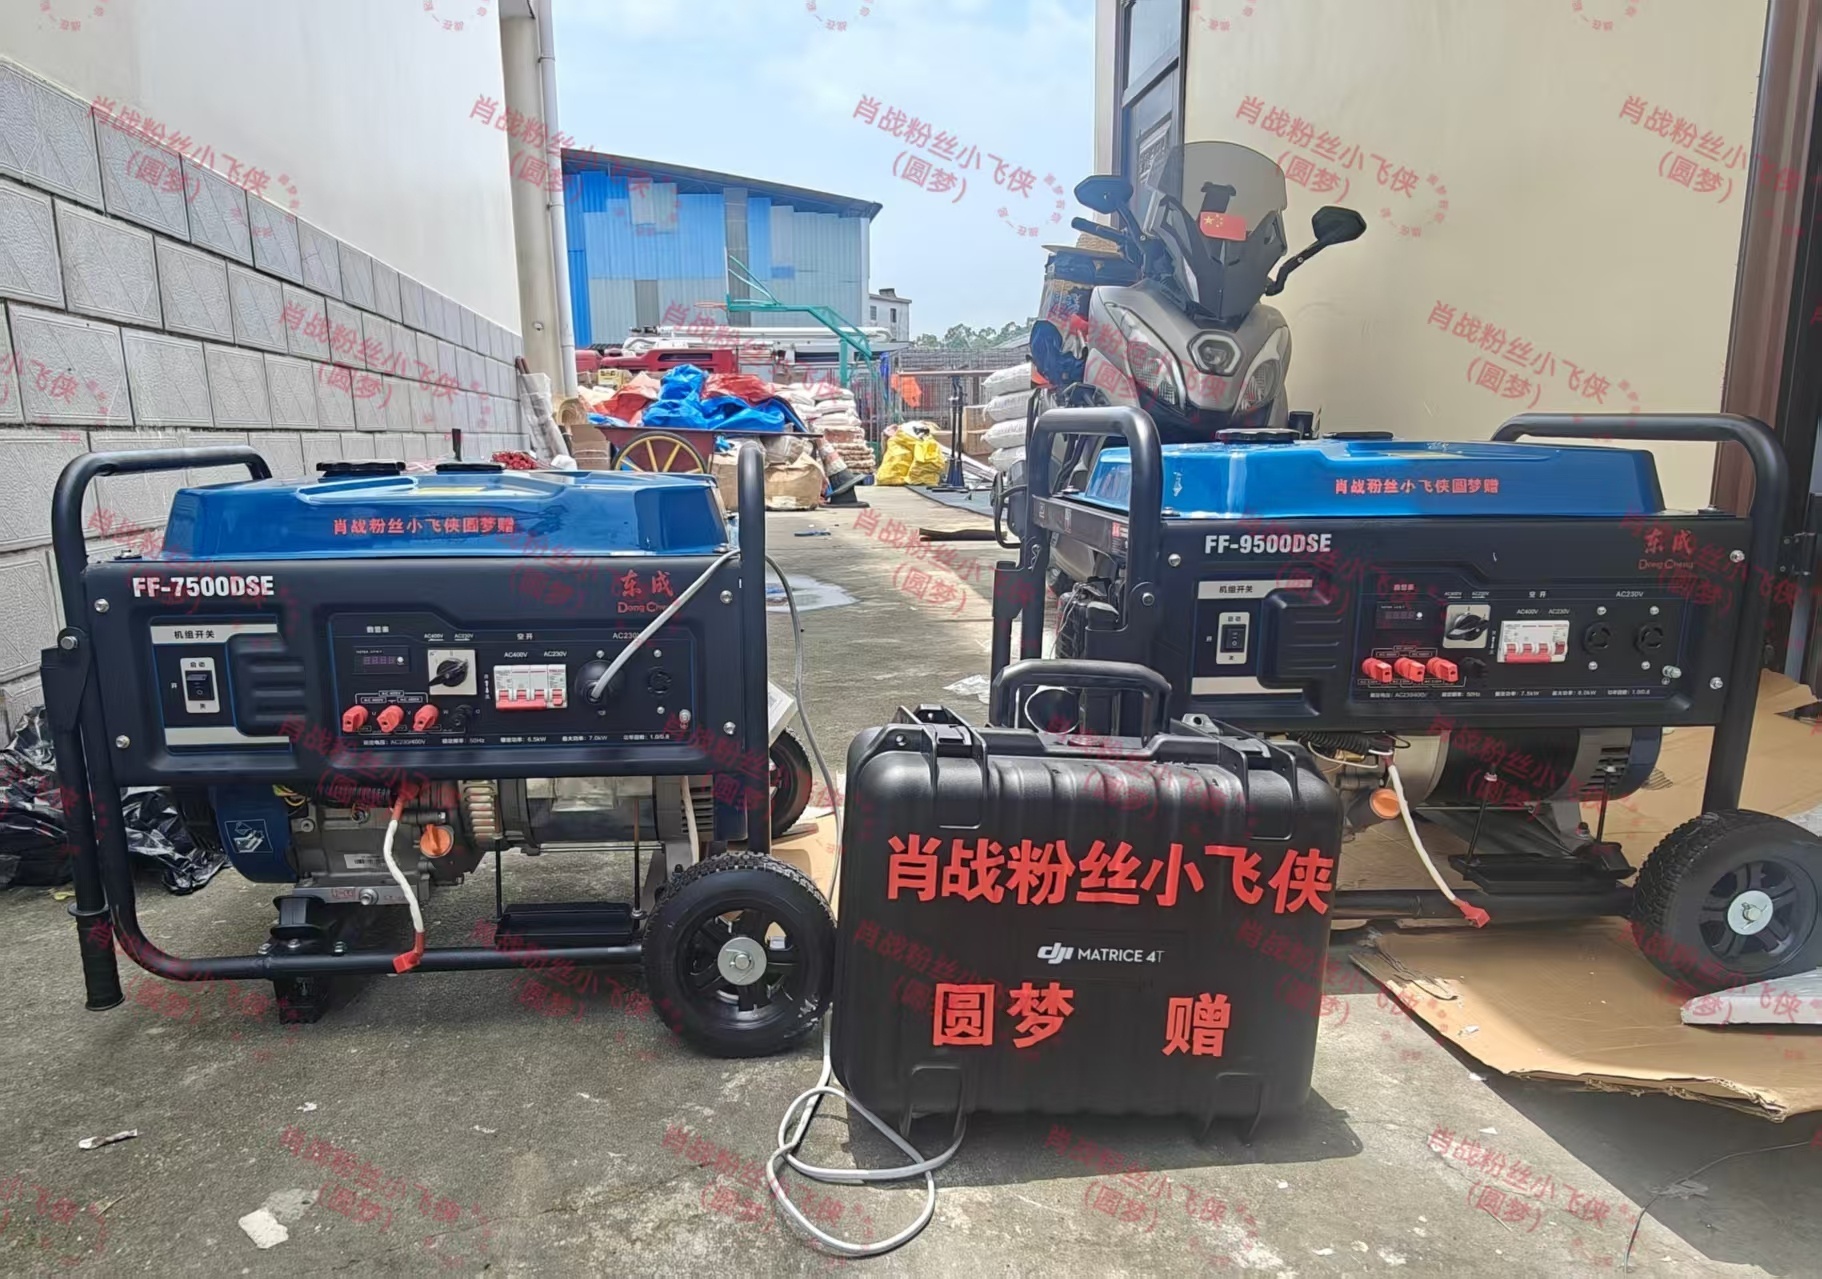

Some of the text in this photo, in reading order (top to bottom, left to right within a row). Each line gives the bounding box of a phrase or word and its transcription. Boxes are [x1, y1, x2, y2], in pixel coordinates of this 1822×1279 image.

[1335, 478, 1499, 495] 肖战粉丝小飞侠圆梦赠
[333, 517, 514, 535] 肖战粉丝小飞侠圆梦赠
[1205, 533, 1332, 554] FF-9500DSE
[132, 575, 274, 598] FF-7500DSE
[1219, 585, 1253, 593] 机组开关
[174, 630, 215, 639] 机组开关
[887, 833, 1334, 915] 肖战粉丝小飞侠
[1077, 948, 1144, 962] MATRICE
[1145, 950, 1166, 963] 4T
[932, 981, 1075, 1049] 圆梦
[1162, 992, 1232, 1058] 赠
